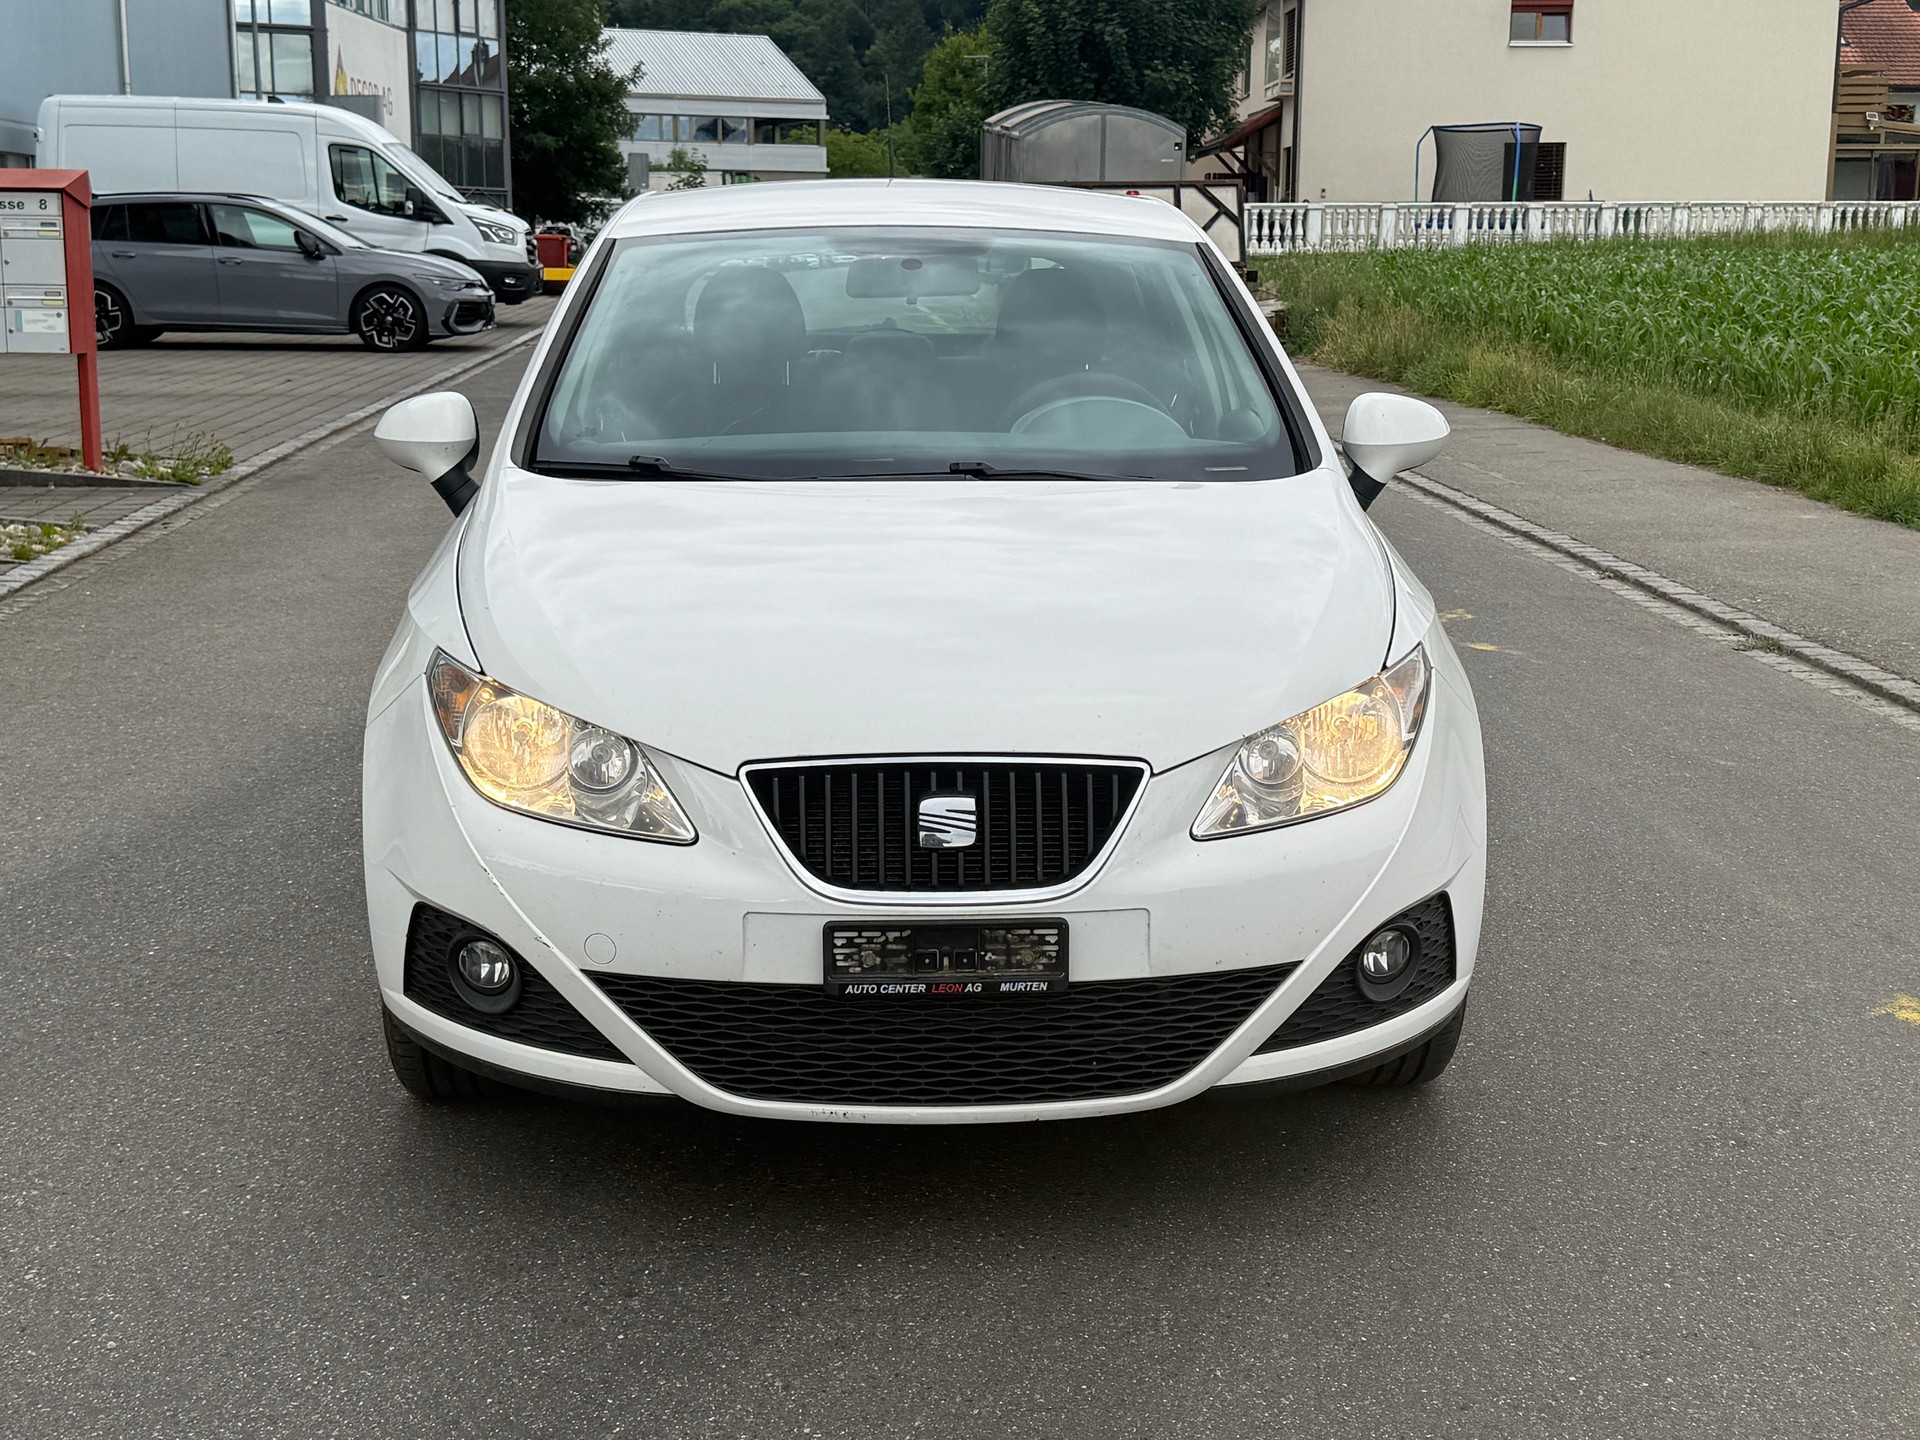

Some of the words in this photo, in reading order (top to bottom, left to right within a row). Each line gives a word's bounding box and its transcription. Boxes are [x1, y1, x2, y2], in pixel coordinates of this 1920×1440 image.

[39, 198, 47, 210] 8
[845, 984, 877, 994] AUTO
[880, 984, 926, 994] CENTER
[932, 984, 963, 993] LEON
[964, 983, 983, 993] AG
[1000, 982, 1048, 992] MURTEN
